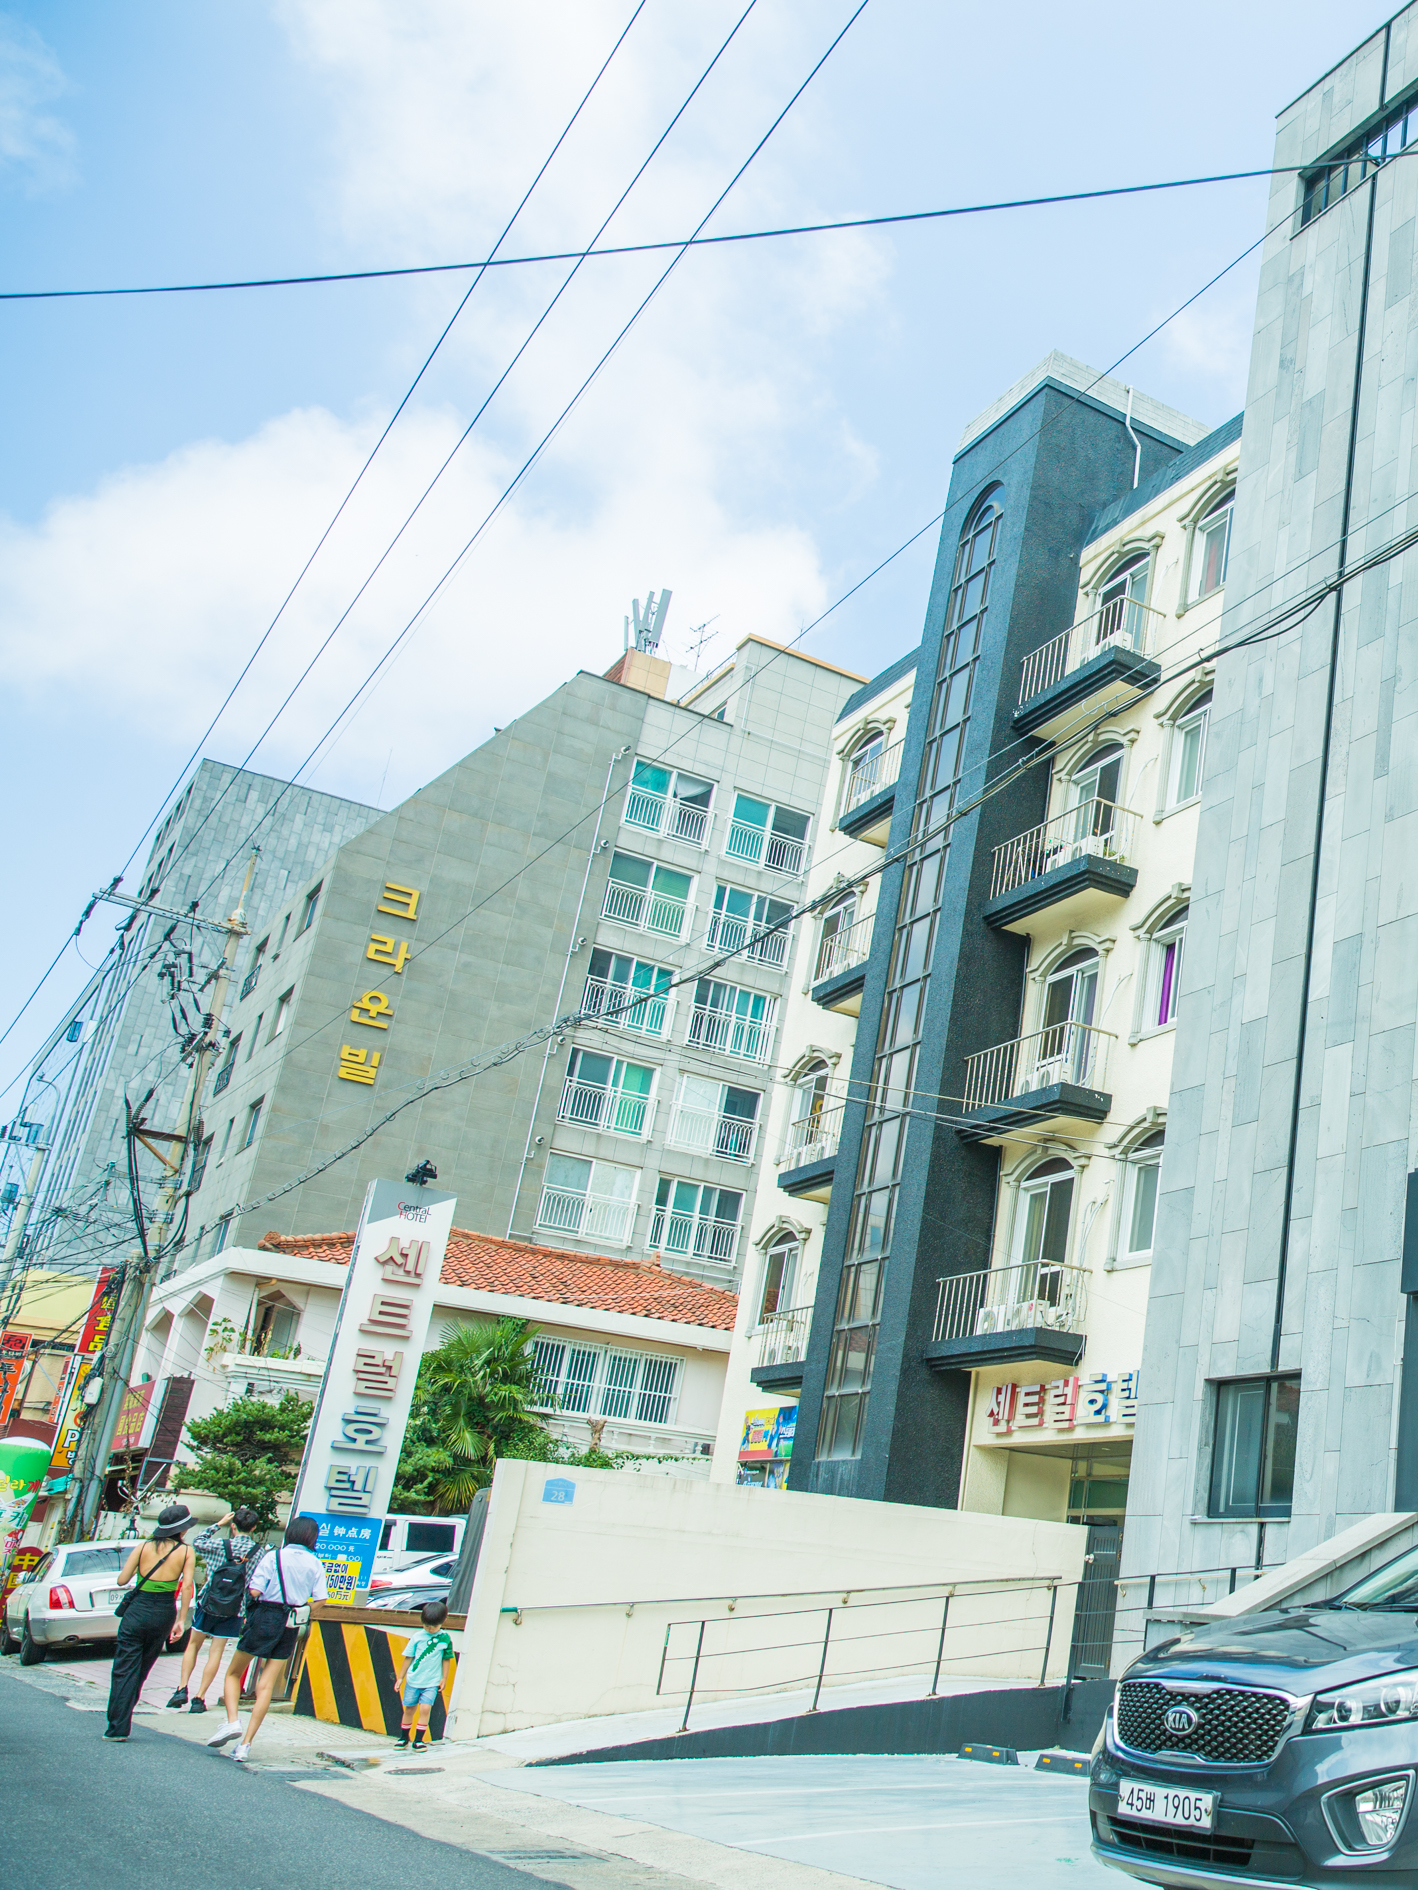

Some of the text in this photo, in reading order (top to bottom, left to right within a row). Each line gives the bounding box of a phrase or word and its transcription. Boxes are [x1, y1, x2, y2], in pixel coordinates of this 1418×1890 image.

[338, 882, 421, 1085] 크라운빌
[323, 1236, 430, 1514] 센트럴호텔
[551, 1491, 565, 1501] 28
[333, 1525, 371, 1539] 钟点房
[1167, 1712, 1189, 1729] KIA
[1126, 1787, 1203, 1822] 45버 1905
